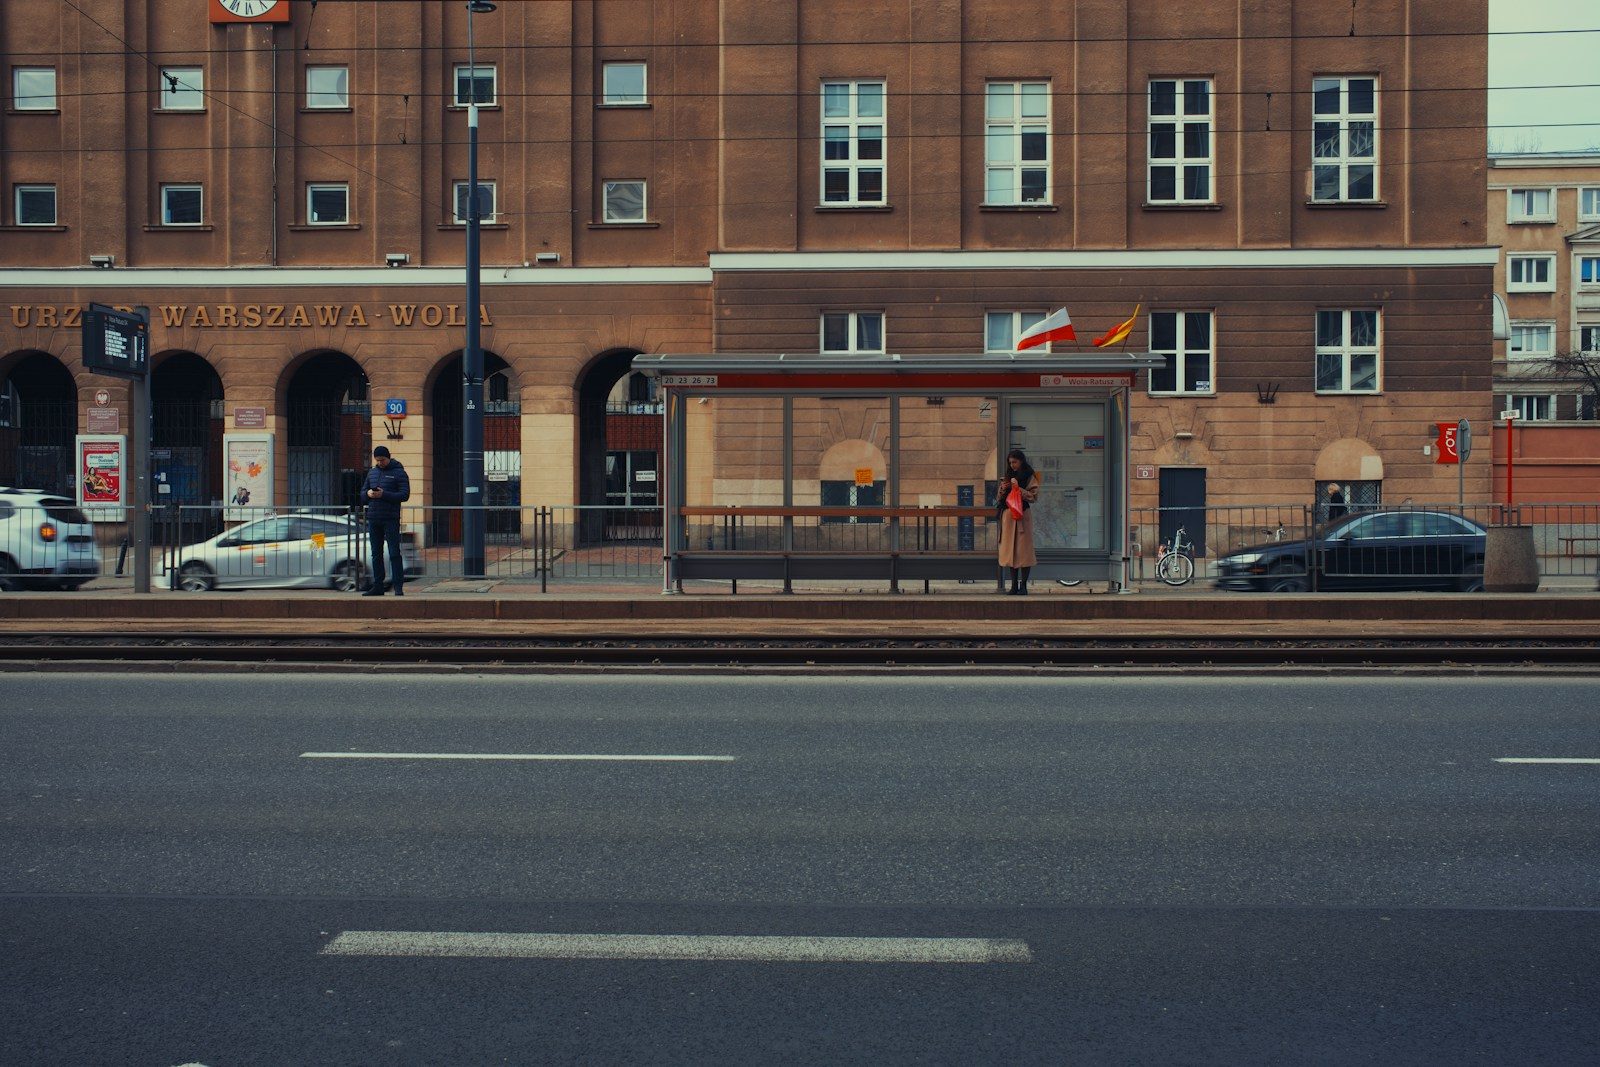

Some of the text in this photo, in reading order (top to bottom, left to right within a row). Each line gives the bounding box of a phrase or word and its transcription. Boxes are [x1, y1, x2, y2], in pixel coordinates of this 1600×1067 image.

[159, 304, 369, 327] WARSZAWA
[1068, 377, 1114, 385] Wola-Ratusz
[390, 403, 402, 414] 90
